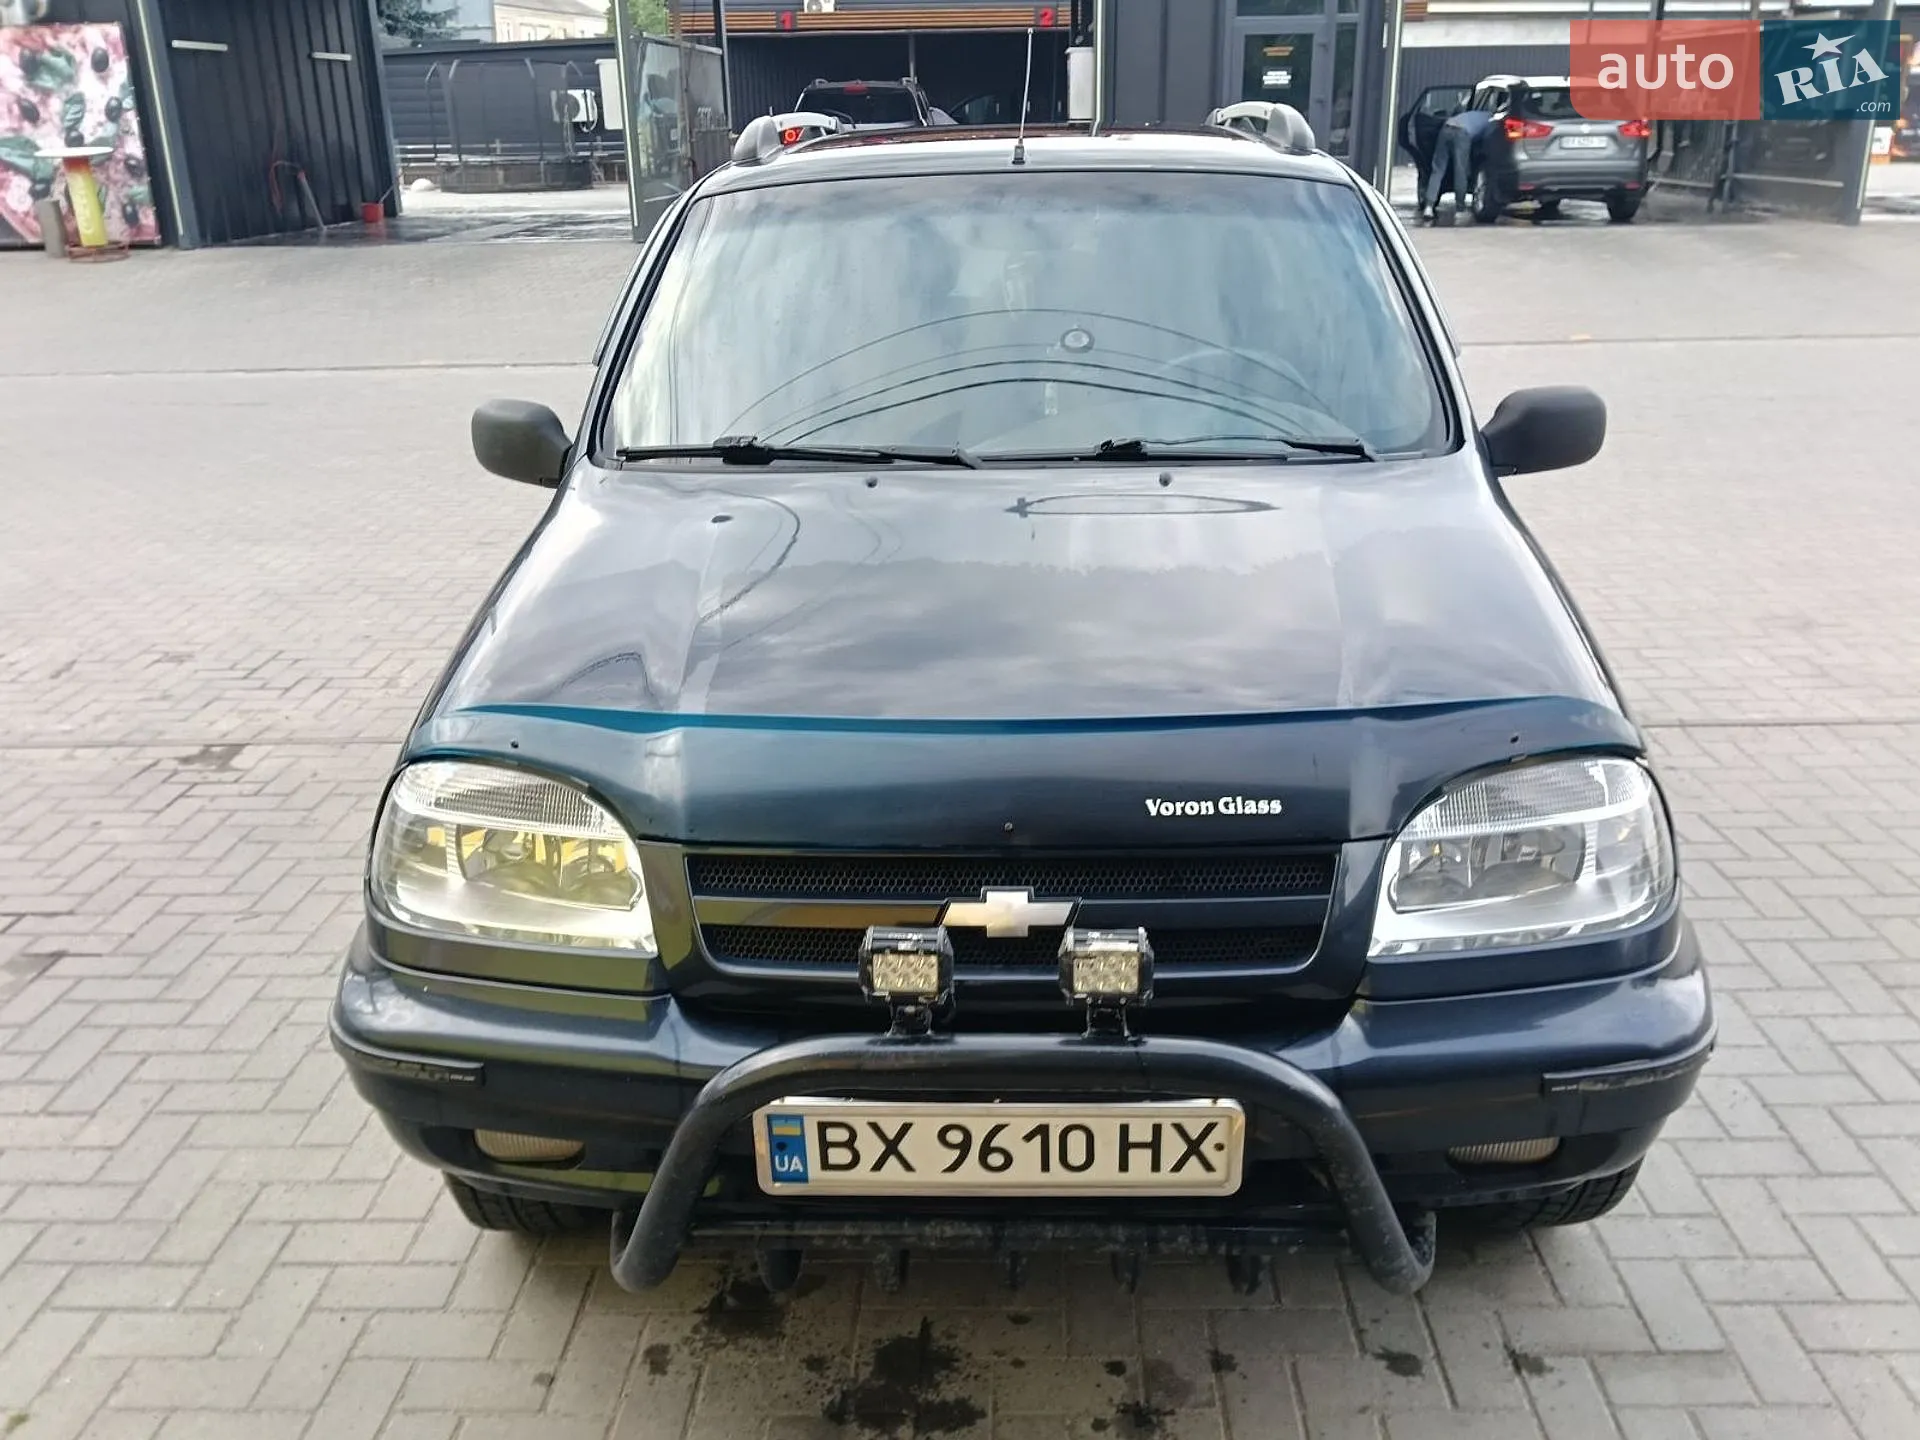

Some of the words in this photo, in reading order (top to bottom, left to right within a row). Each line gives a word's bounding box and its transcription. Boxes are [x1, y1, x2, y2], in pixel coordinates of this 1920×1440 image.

[781, 11, 792, 29] 1
[1041, 8, 1053, 26] 2
[1145, 798, 1215, 816] Voron
[1218, 796, 1283, 815] Glass
[816, 1120, 917, 1172] BX
[936, 1122, 1096, 1173] 9610
[1117, 1121, 1219, 1173] HX
[775, 1155, 804, 1173] UA
